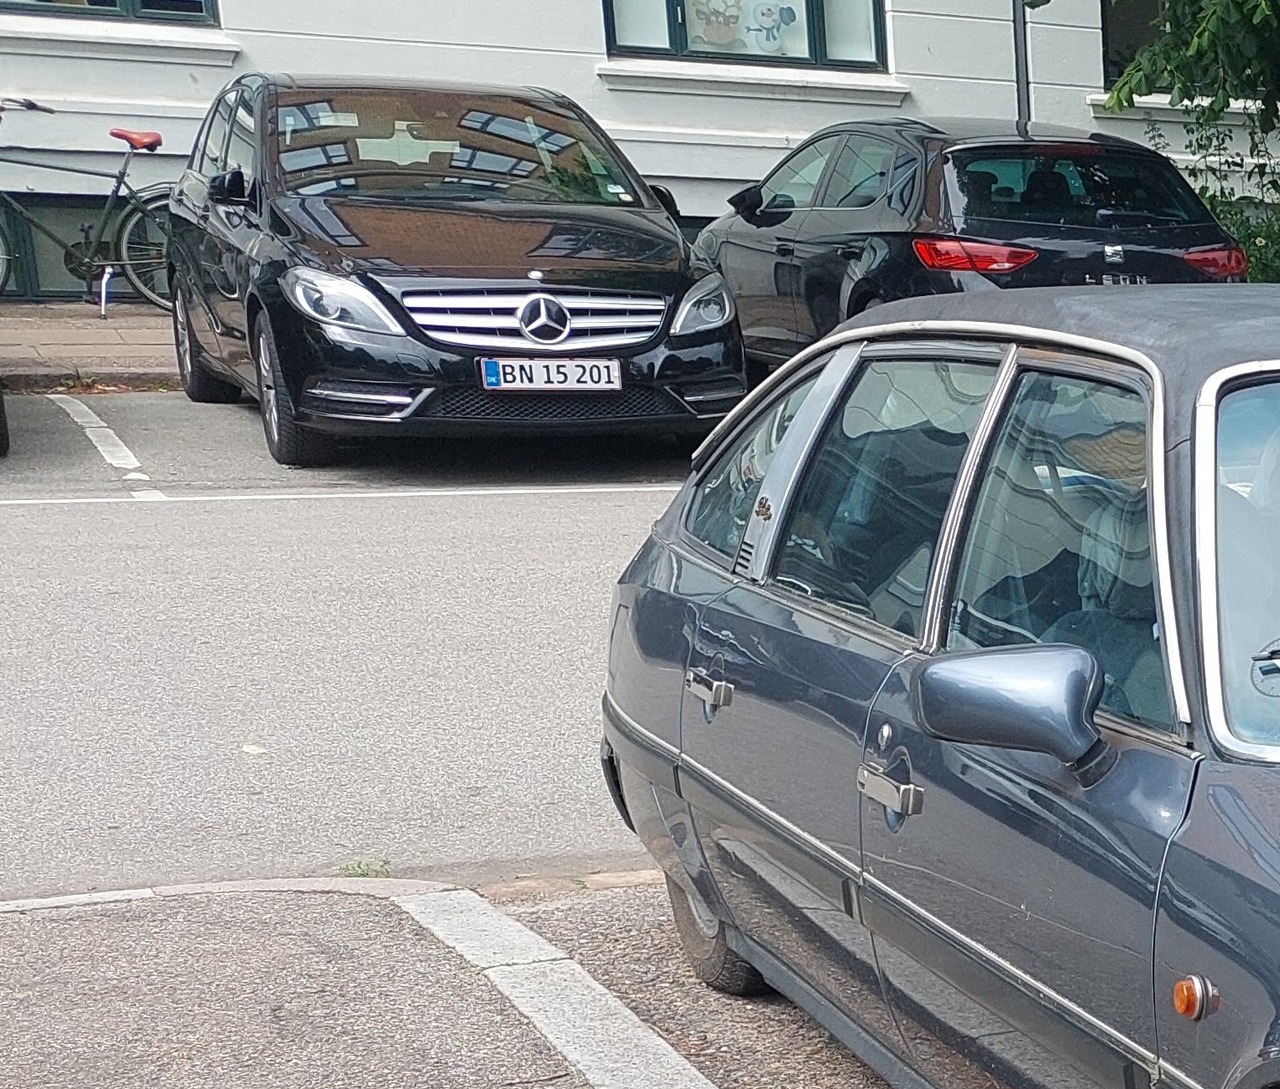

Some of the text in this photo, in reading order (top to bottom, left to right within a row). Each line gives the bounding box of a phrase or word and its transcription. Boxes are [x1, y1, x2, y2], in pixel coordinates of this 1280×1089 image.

[502, 364, 614, 384] BN 15 201
